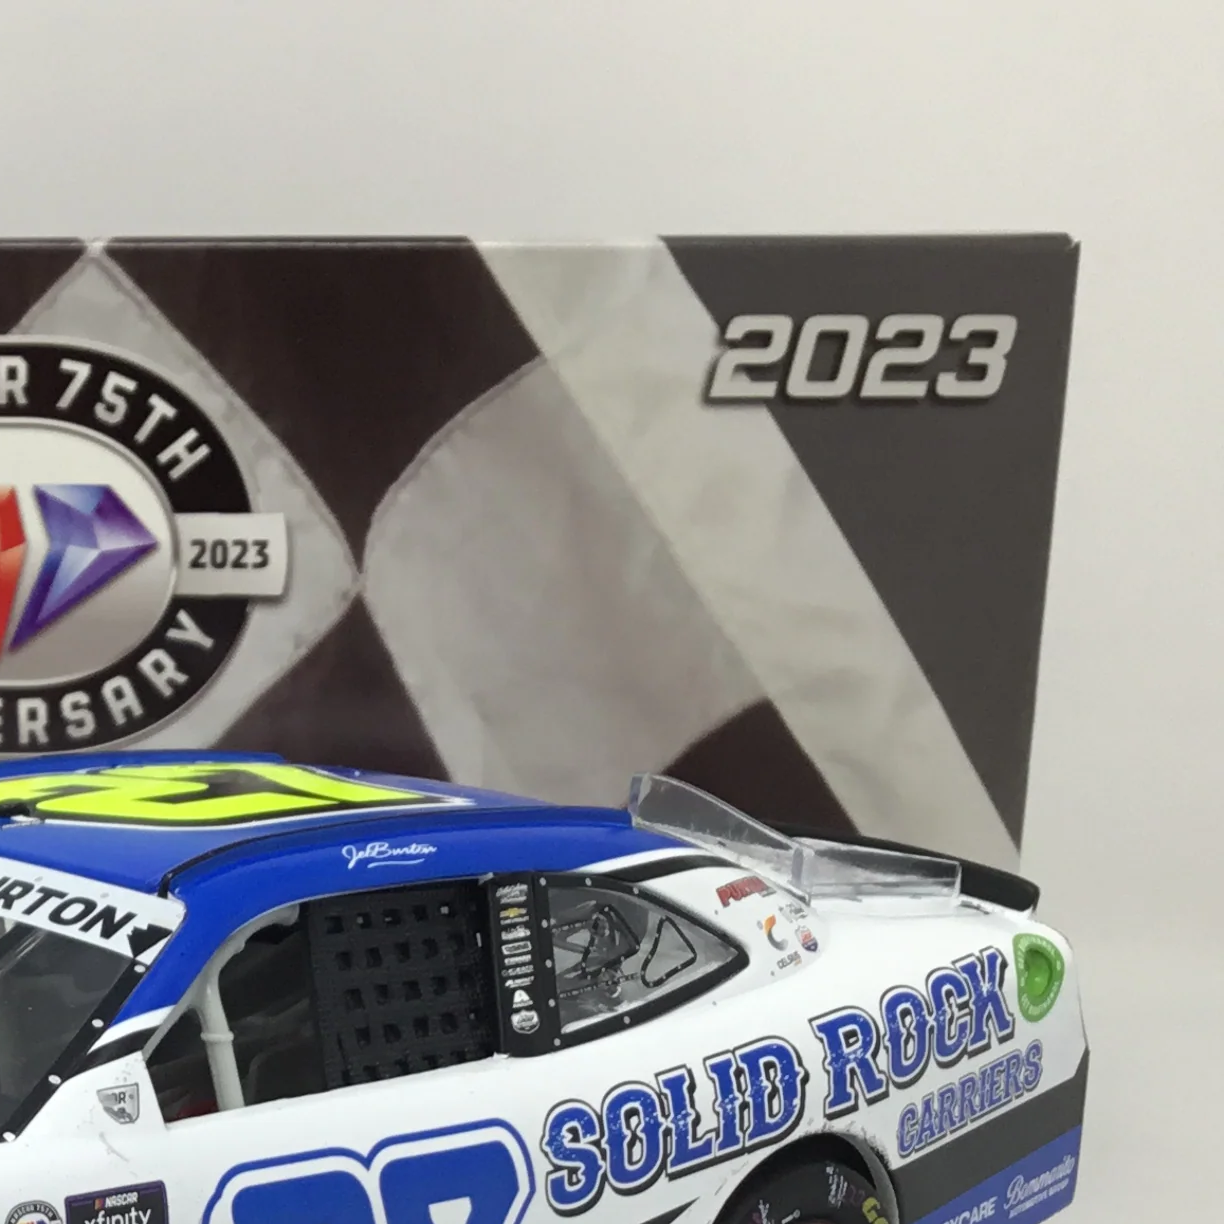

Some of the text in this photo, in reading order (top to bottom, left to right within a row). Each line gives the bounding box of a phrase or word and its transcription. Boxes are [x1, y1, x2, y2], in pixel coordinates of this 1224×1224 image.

[708, 313, 1018, 399] 2023
[56, 358, 212, 481] 75TH
[188, 538, 271, 570] 2023
[541, 1036, 809, 1217] SOLID
[808, 945, 1016, 1121] ROCK
[896, 1039, 1044, 1158] CARRIERS
[104, 1191, 139, 1209] NASCAR
